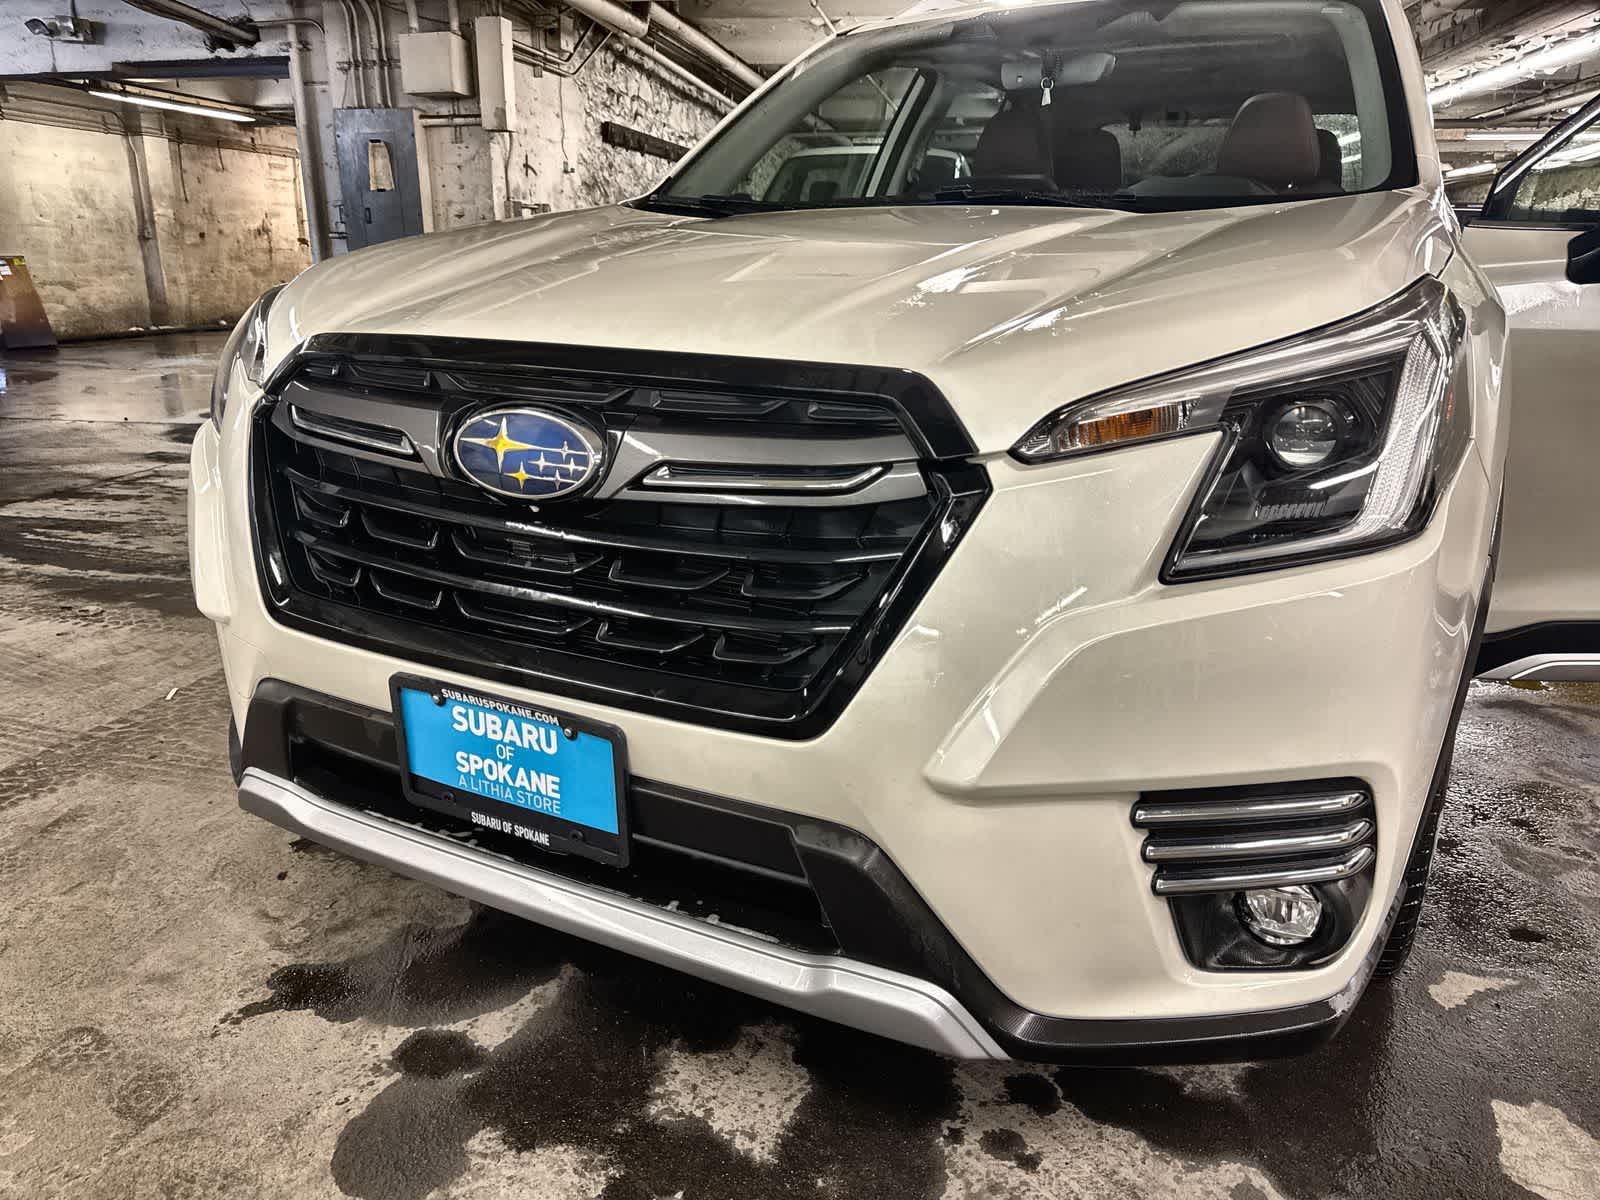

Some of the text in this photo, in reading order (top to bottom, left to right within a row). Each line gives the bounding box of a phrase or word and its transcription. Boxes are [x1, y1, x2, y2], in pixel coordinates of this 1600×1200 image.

[441, 688, 560, 727] SUBARUSPOKANE.COM
[452, 705, 558, 755] SUBARU
[495, 743, 515, 760] OF
[455, 751, 561, 799] SPOKANE
[458, 775, 561, 815] A LITHIA STORE
[471, 811, 550, 846] SUBARU OF SPOKANE
